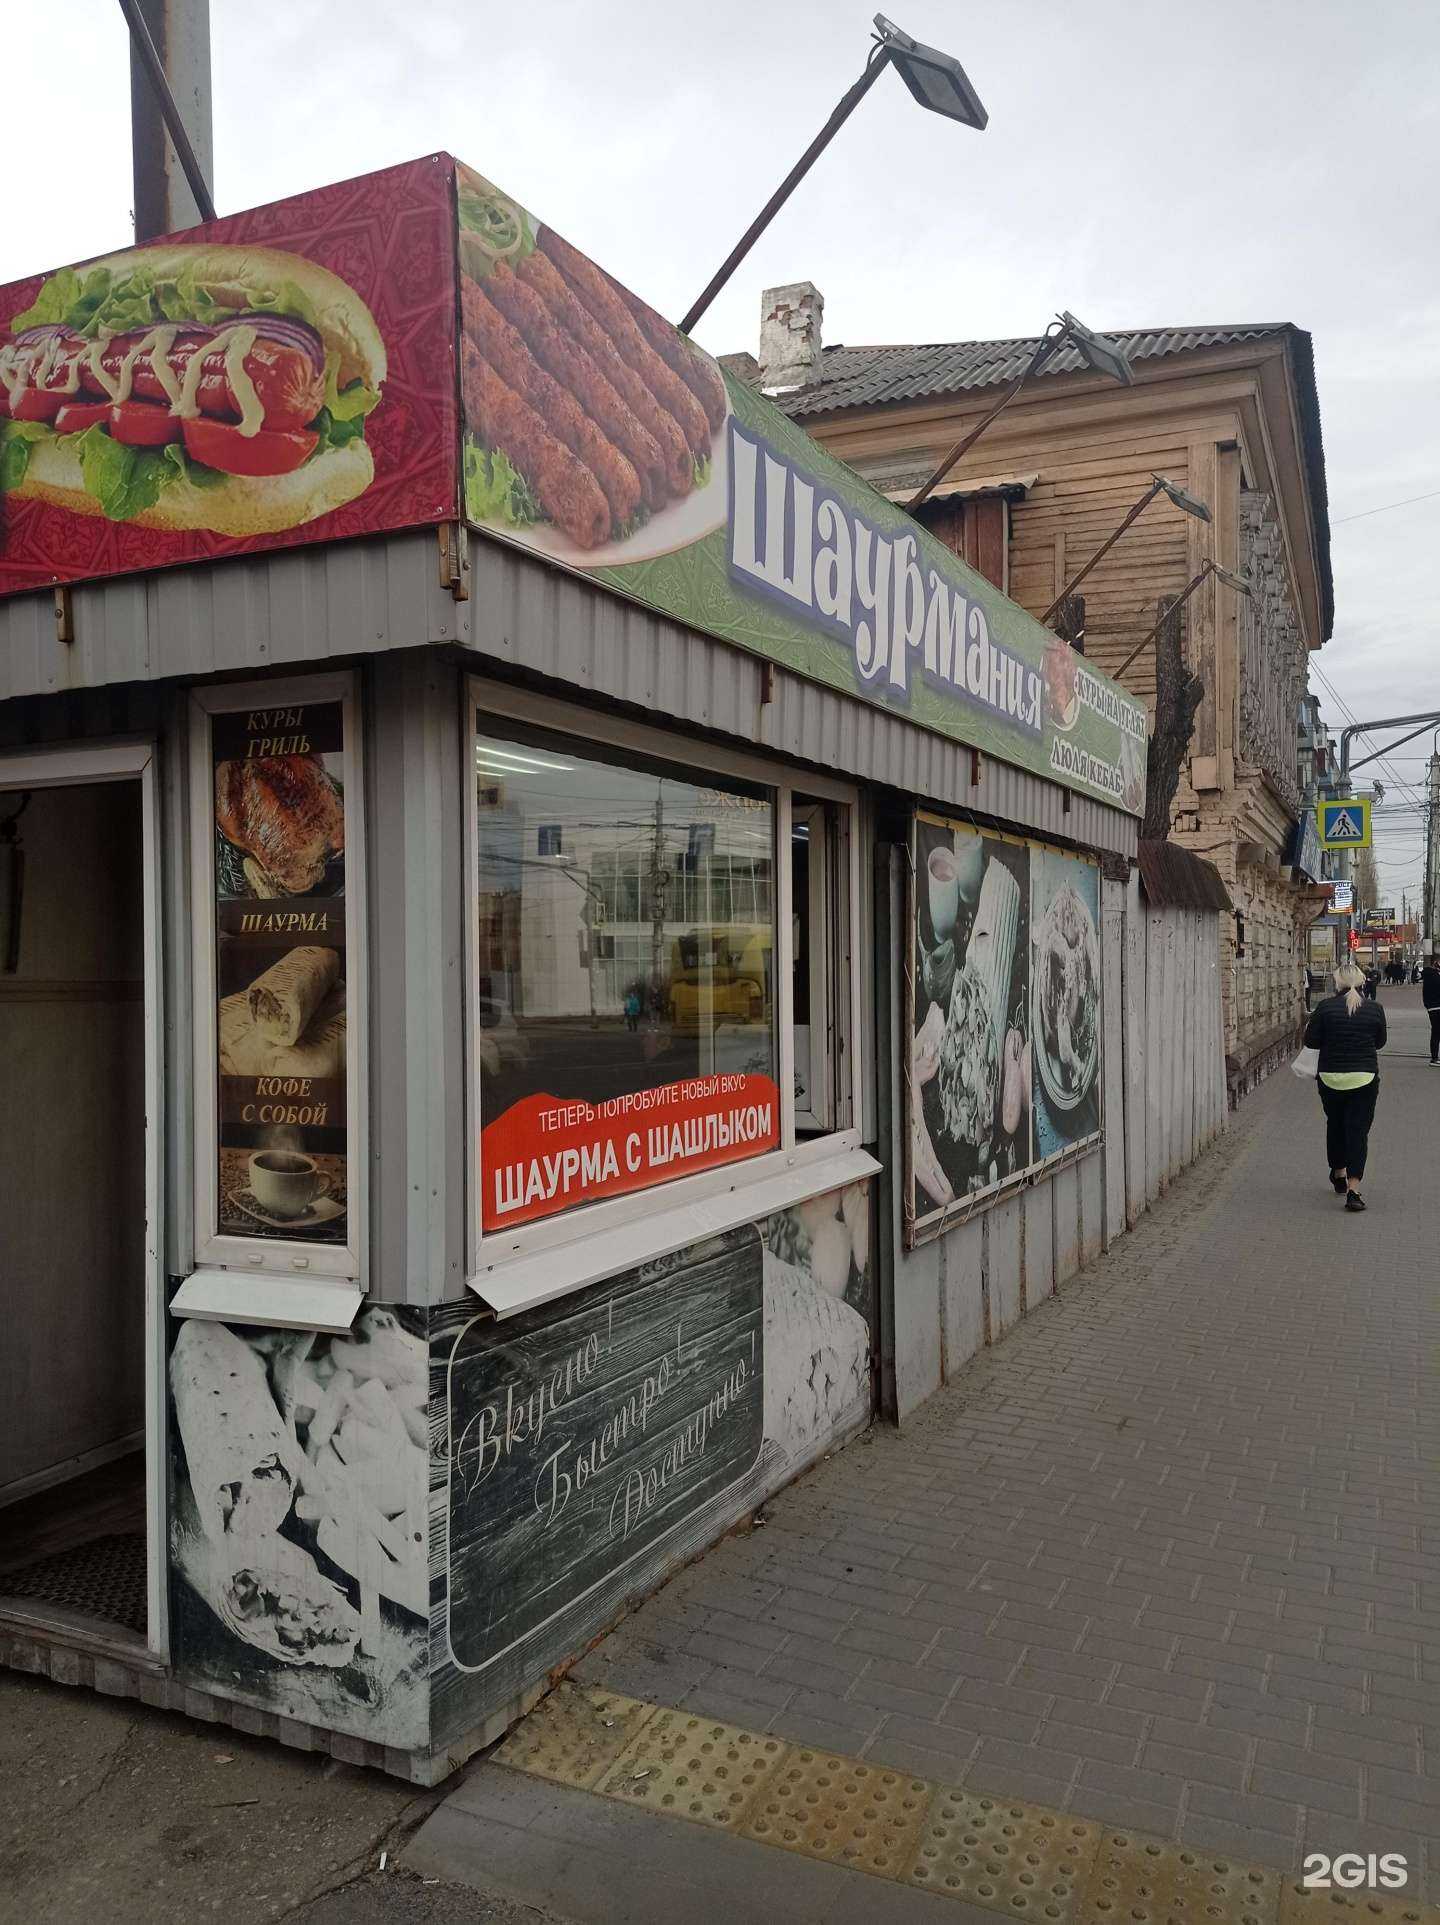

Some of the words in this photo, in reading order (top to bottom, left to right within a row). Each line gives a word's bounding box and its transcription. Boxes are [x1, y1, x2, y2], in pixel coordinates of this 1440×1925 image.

[247, 708, 304, 730] КУРЫ
[247, 735, 311, 758] ГРИЛЬ
[1052, 741, 1087, 778] ЛЮЛЯ
[1088, 757, 1122, 792] КЕБАБ
[240, 912, 328, 932] ШАУРМА
[256, 1077, 312, 1097] КОФЕ
[539, 1106, 594, 1132] ТЕПЕРЬ
[598, 1085, 679, 1120] ПОПРОБУЙТЕ
[681, 1075, 719, 1102] НОВЫЙ
[721, 1073, 747, 1095] ВКУС
[242, 1104, 255, 1123] С
[259, 1103, 328, 1125] СОБОЙ
[495, 1139, 620, 1215] ШАУРМА
[625, 1132, 642, 1173] С
[648, 1103, 772, 1167] ШАШЛЫКОМ
[457, 1297, 613, 1503] Вкусно!
[534, 1322, 684, 1529] Быстро!
[609, 1328, 757, 1542] Доступно!
